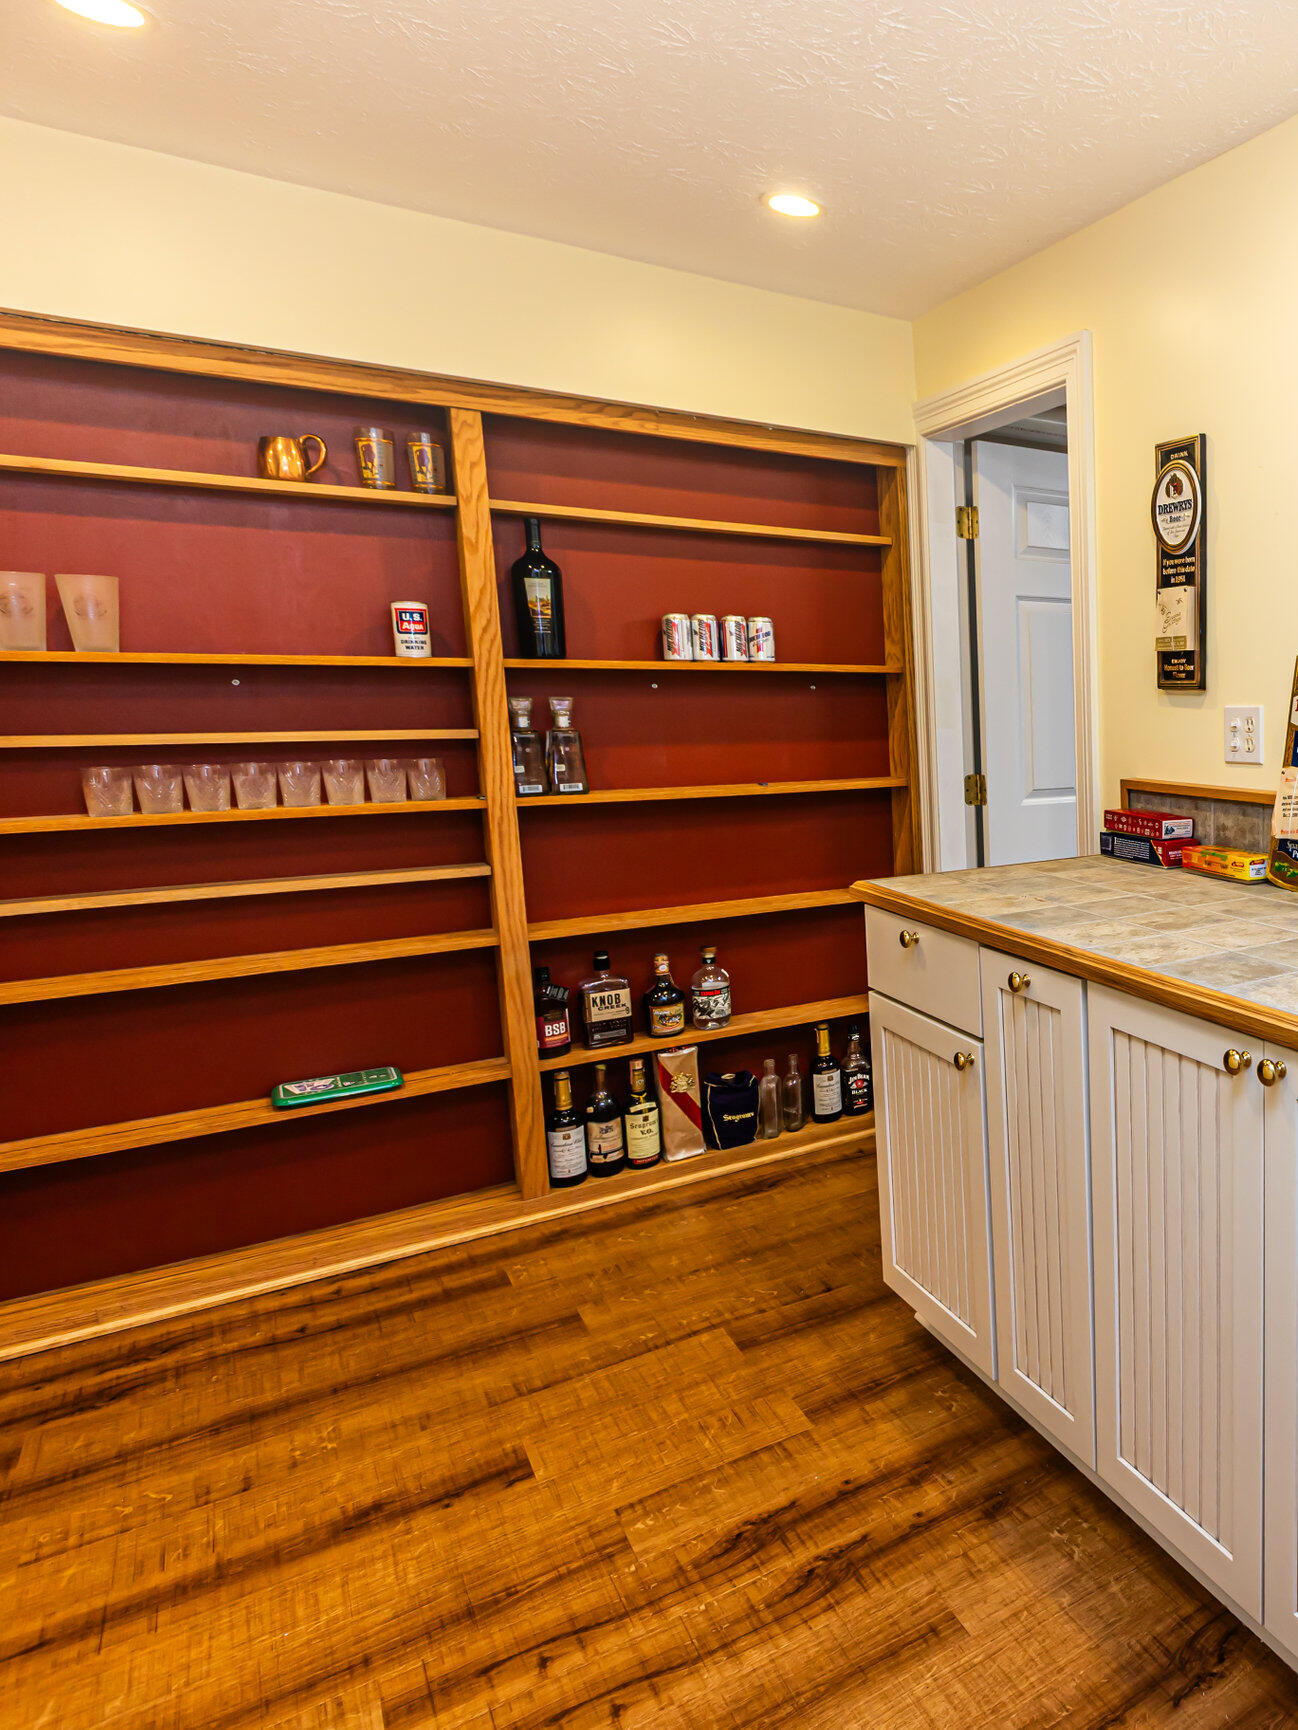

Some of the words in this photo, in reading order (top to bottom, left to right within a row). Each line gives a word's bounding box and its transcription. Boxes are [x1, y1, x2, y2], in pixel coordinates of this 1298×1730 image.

[1158, 499, 1193, 515] DREWRYS
[591, 993, 621, 1007] KNOB
[597, 1002, 627, 1011] CREEK
[544, 1021, 566, 1037] BSB
